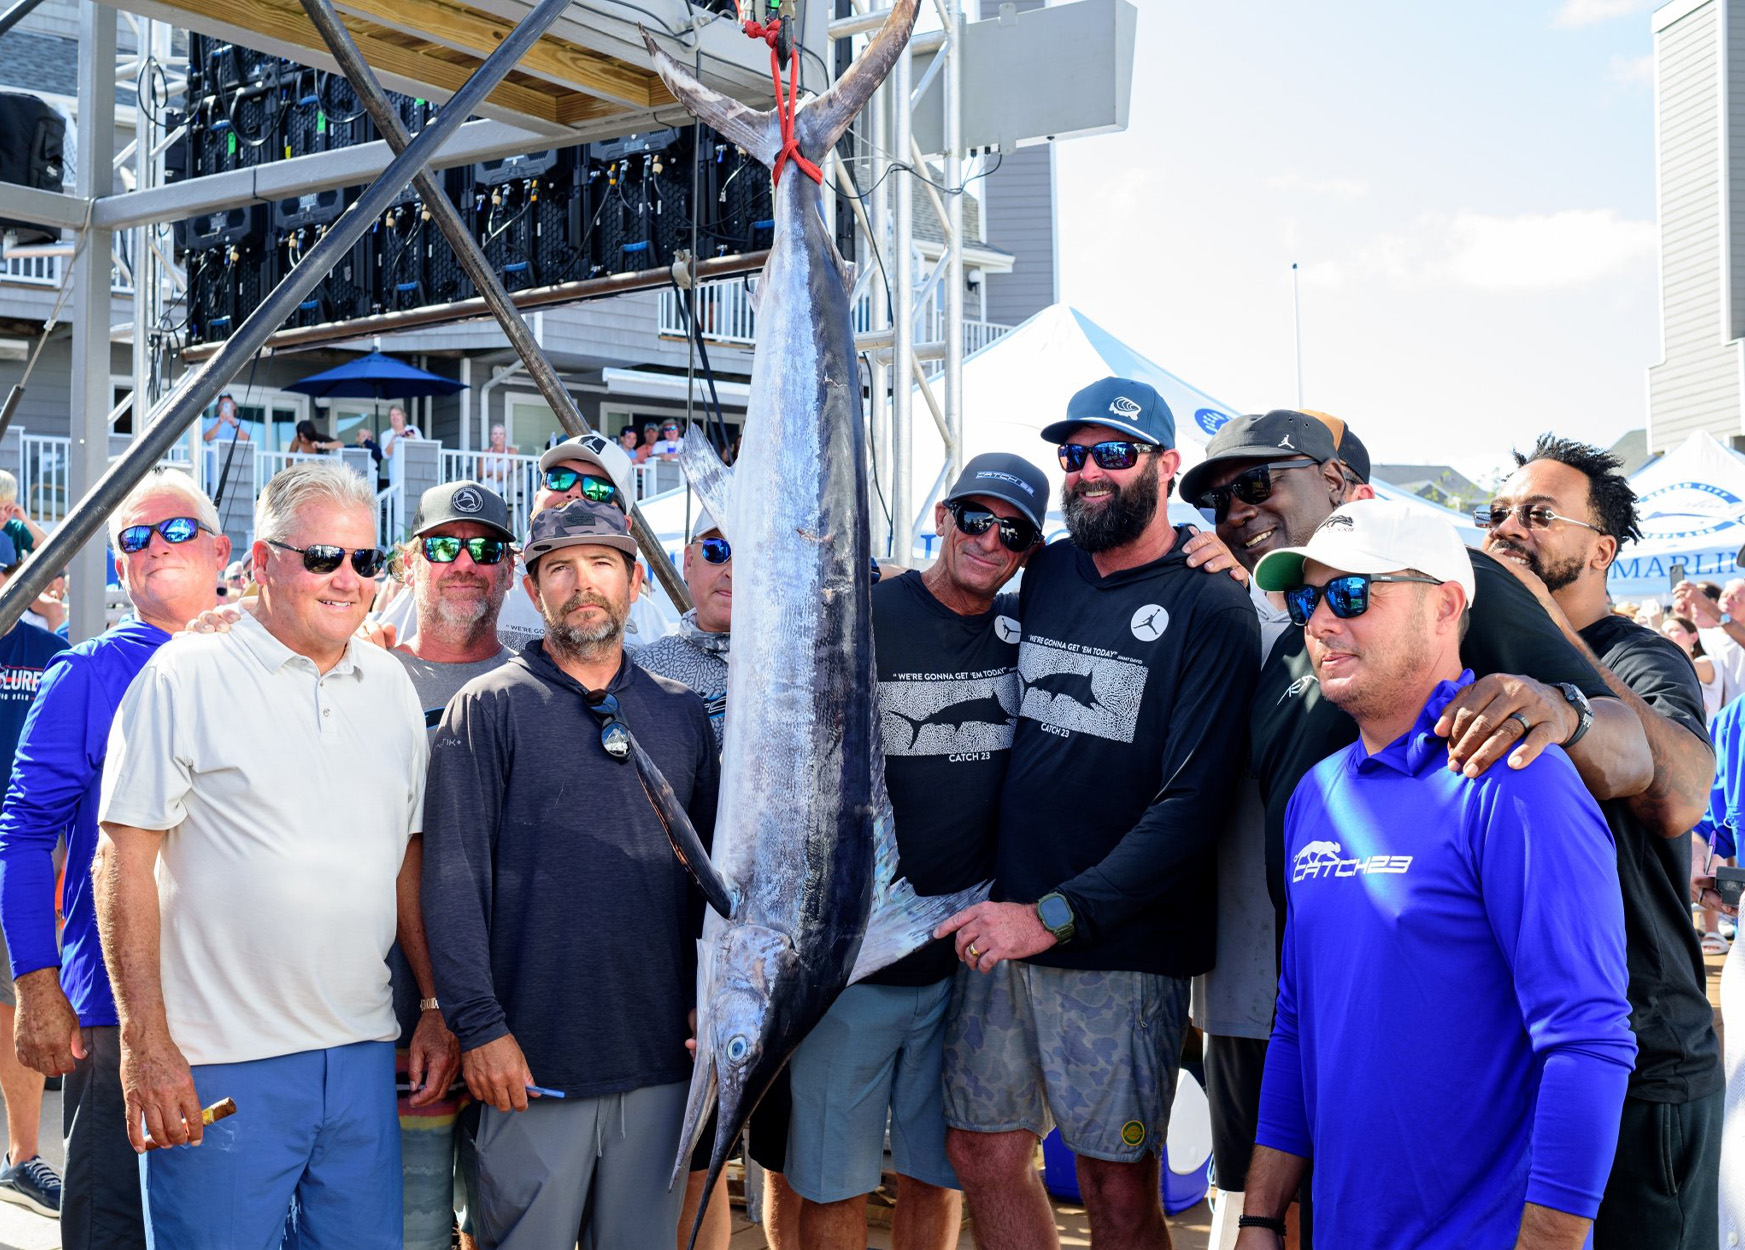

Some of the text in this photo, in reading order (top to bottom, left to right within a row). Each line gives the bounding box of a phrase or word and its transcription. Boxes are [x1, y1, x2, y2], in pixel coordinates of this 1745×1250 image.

[1044, 638, 1067, 650] GONNA
[1067, 643, 1080, 652] GET
[924, 672, 954, 681] GONNA
[955, 672, 969, 680] GET
[1041, 723, 1070, 738] CATCH 23
[948, 751, 991, 763] CATCH 23
